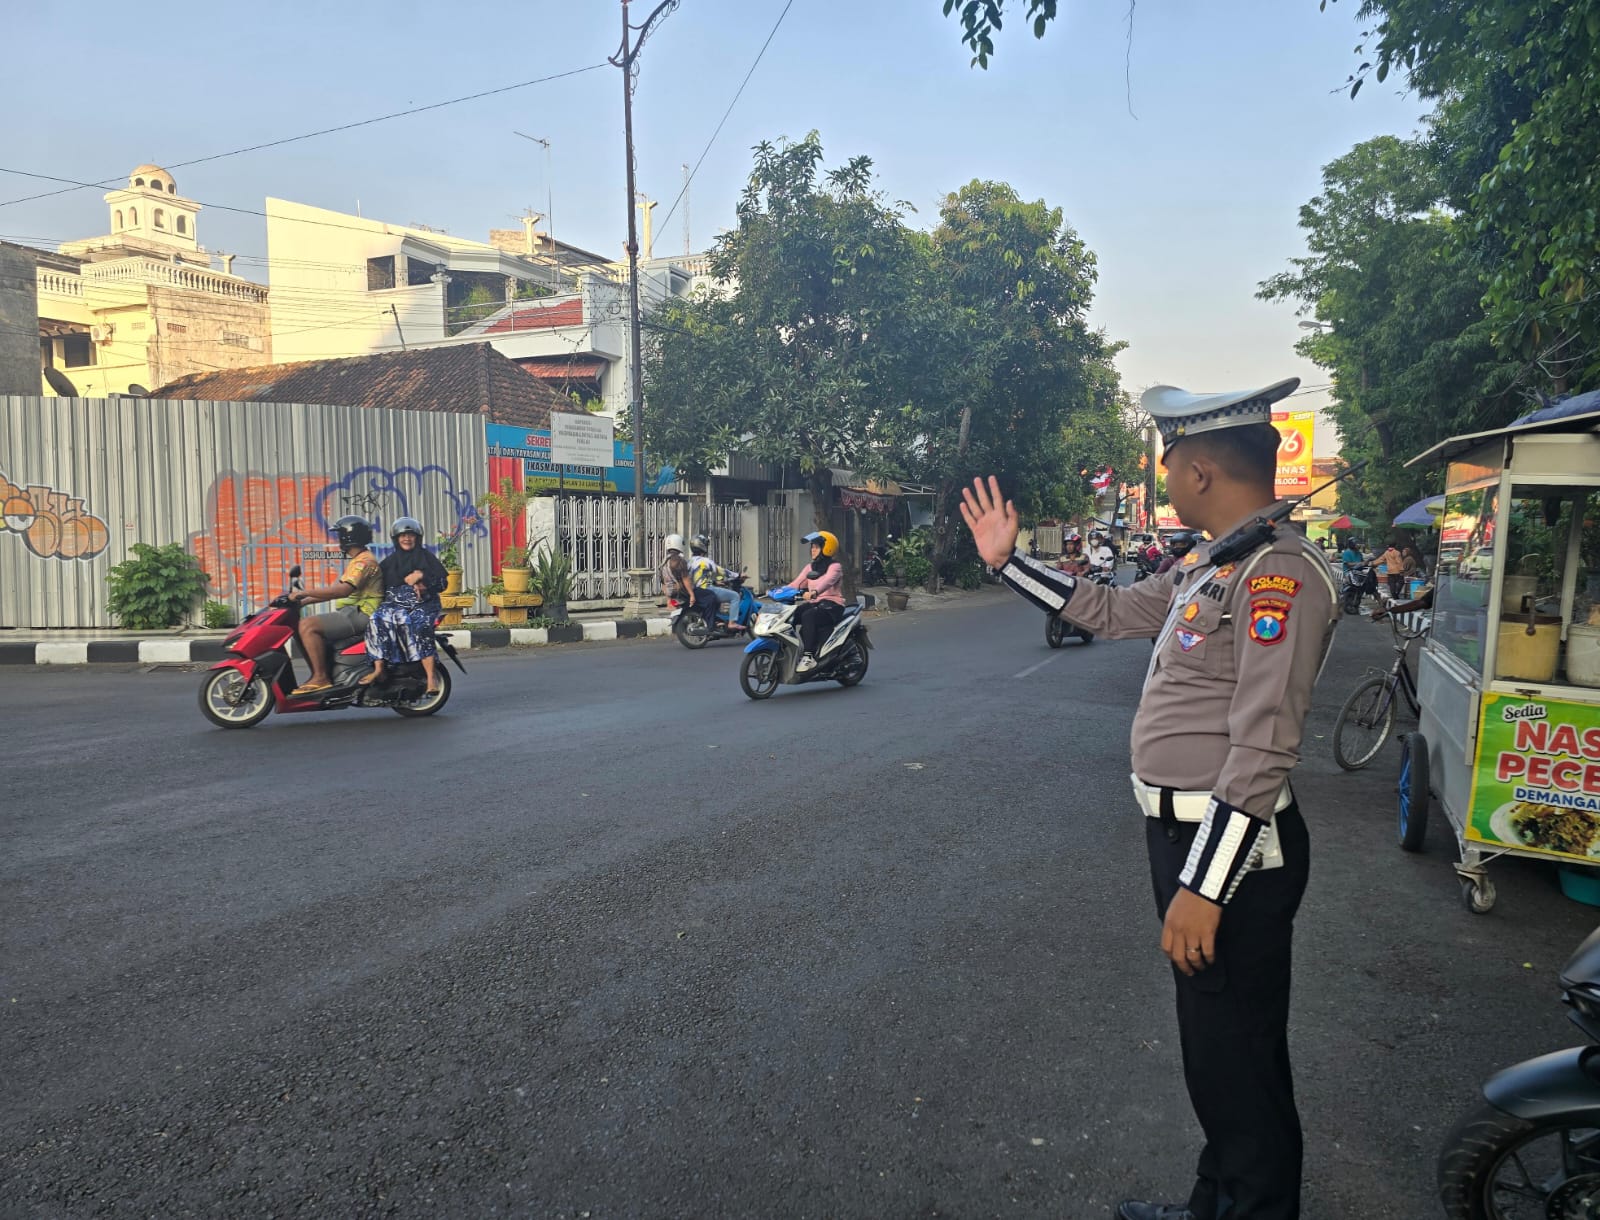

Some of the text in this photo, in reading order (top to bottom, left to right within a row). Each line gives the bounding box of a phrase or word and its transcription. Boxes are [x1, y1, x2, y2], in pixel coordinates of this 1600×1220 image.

[527, 461, 562, 473] IKASMAD
[327, 551, 346, 559] LAMO
[1251, 576, 1296, 588] POLRES
[1504, 704, 1545, 720] Sedia
[1516, 721, 1600, 760] NAS
[1497, 753, 1600, 794] PECE
[1515, 788, 1600, 811] DEMANGA
